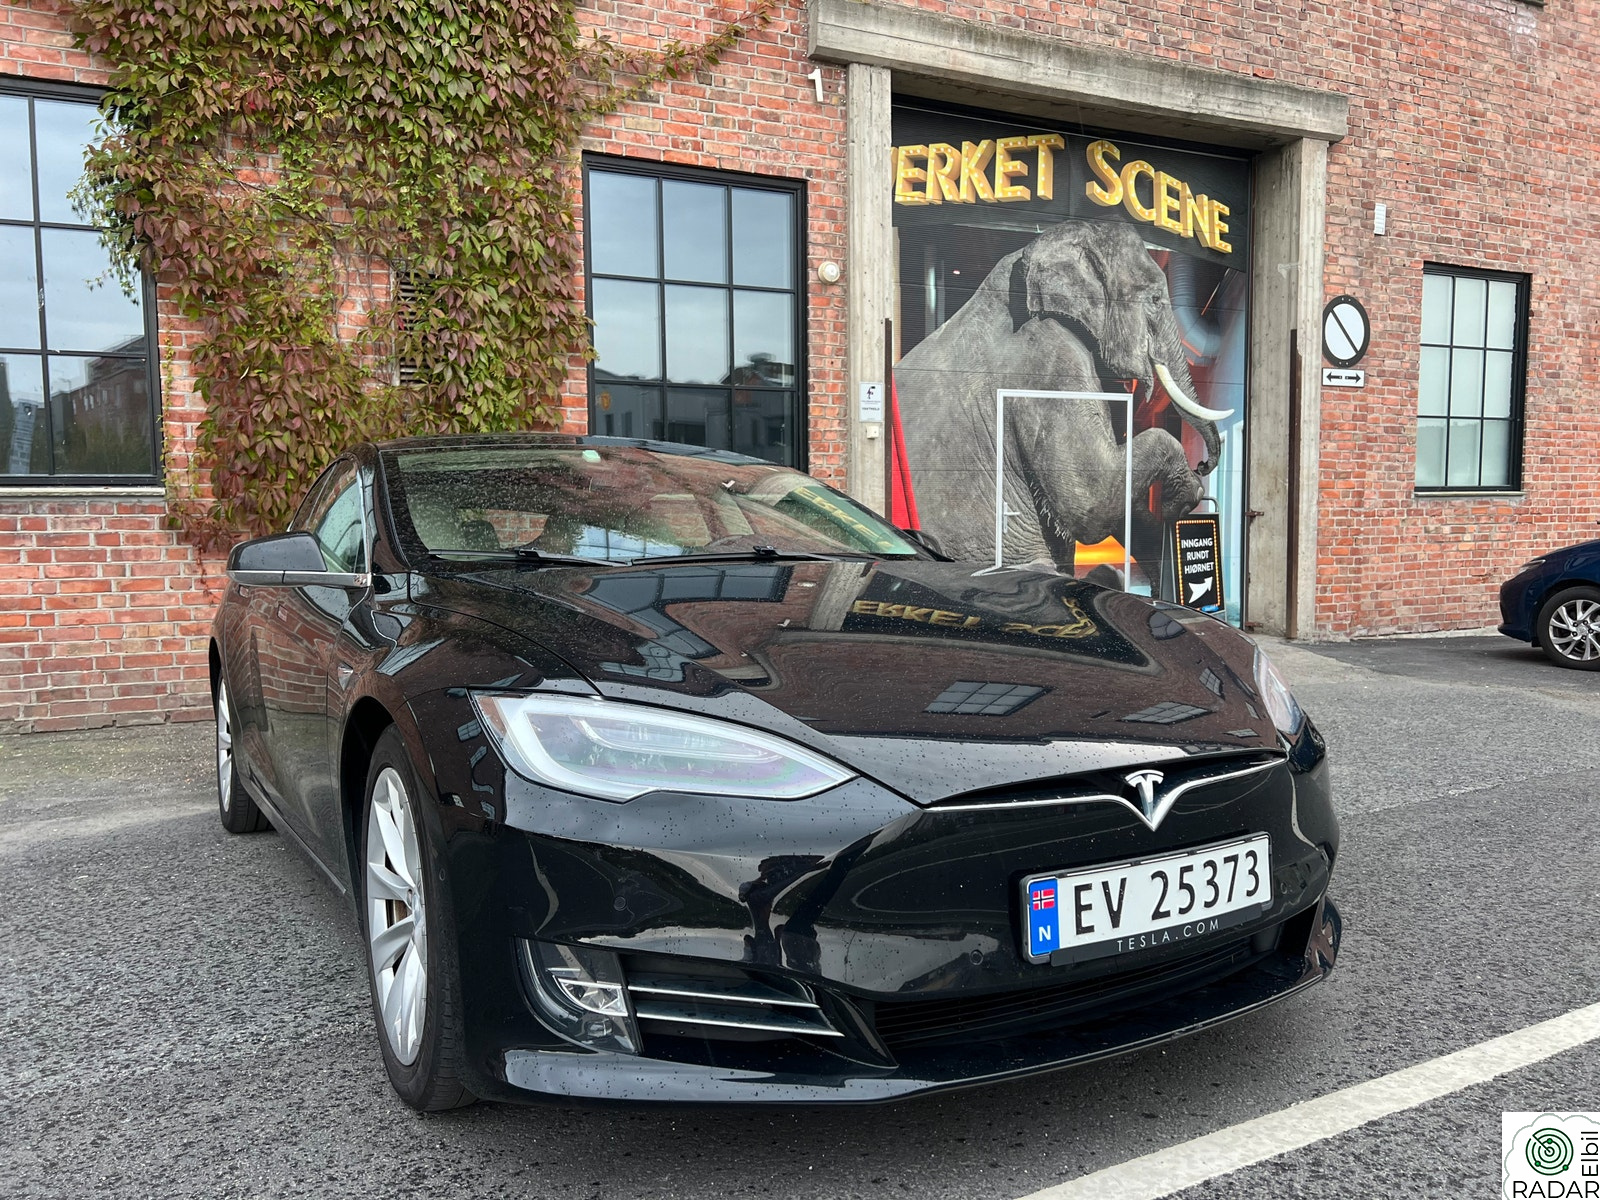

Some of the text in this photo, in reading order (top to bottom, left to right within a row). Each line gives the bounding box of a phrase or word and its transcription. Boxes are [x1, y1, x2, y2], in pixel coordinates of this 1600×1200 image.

[891, 134, 1232, 253] ERKET SCENE
[1181, 538, 1213, 548] INNGANG
[1186, 550, 1209, 561] RUNDT
[1074, 849, 1260, 936] EV 25373
[1038, 925, 1052, 942] N
[1116, 918, 1220, 952] TESLA.COM
